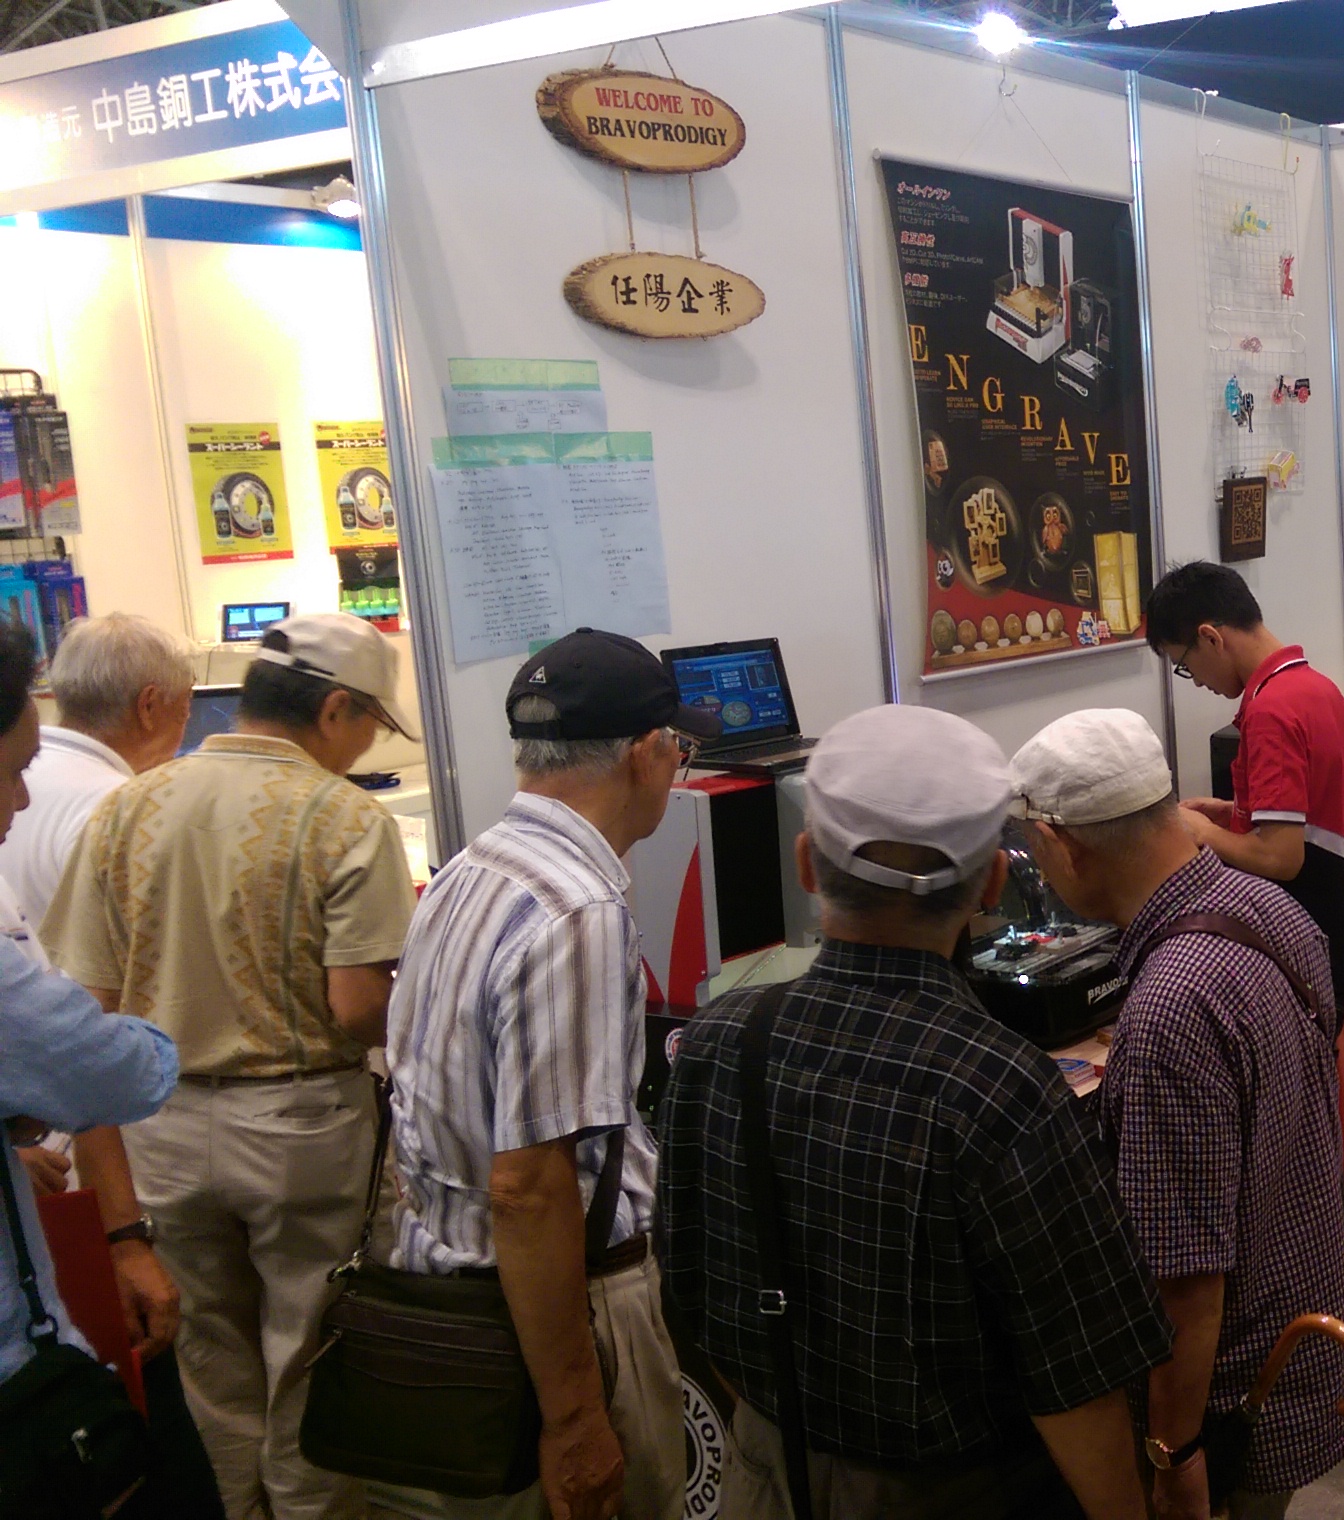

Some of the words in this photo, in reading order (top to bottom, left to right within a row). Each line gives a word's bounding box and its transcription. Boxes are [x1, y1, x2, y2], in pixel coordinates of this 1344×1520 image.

[595, 87, 683, 115] WELCOME
[690, 97, 714, 117] TO
[586, 115, 728, 147] BRAVOPRODIGY
[611, 273, 733, 316] 任陽企業
